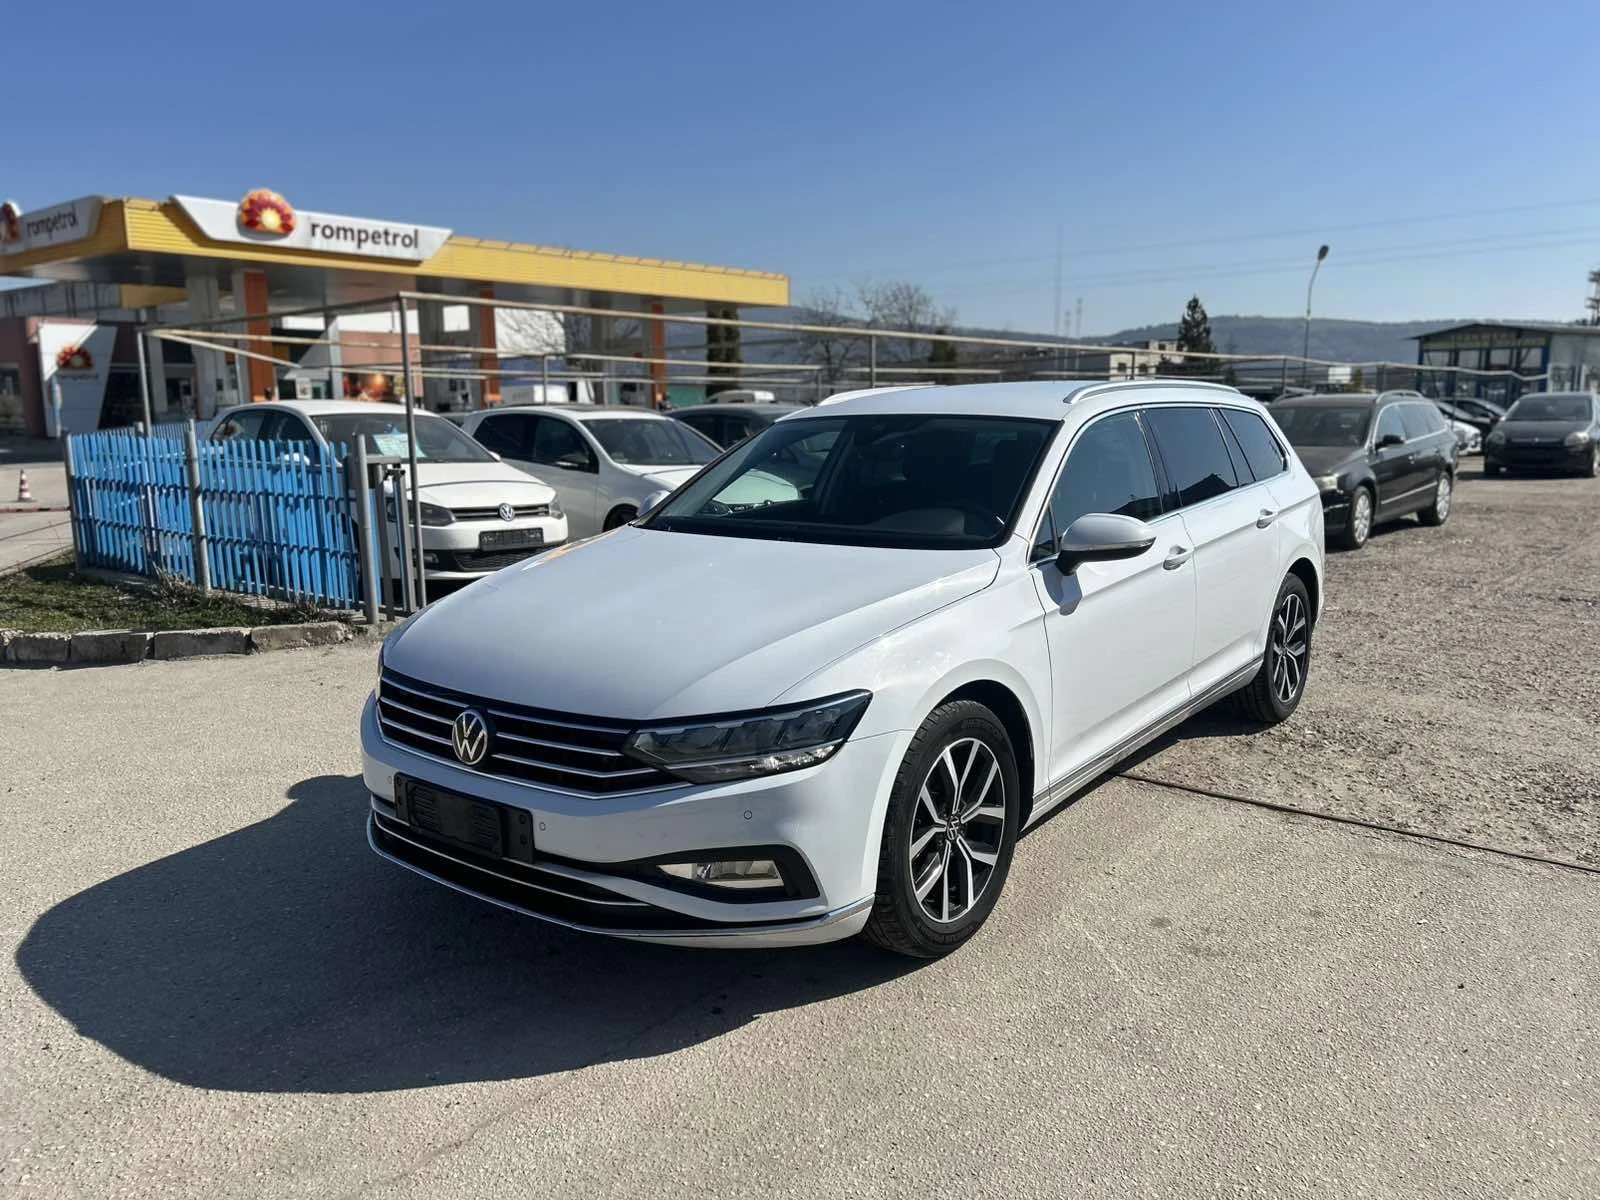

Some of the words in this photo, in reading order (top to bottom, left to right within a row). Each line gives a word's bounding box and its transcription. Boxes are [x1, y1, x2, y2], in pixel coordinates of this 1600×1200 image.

[26, 203, 79, 240] rompetrol
[310, 222, 419, 249] rompetrol
[452, 711, 487, 765] VW
